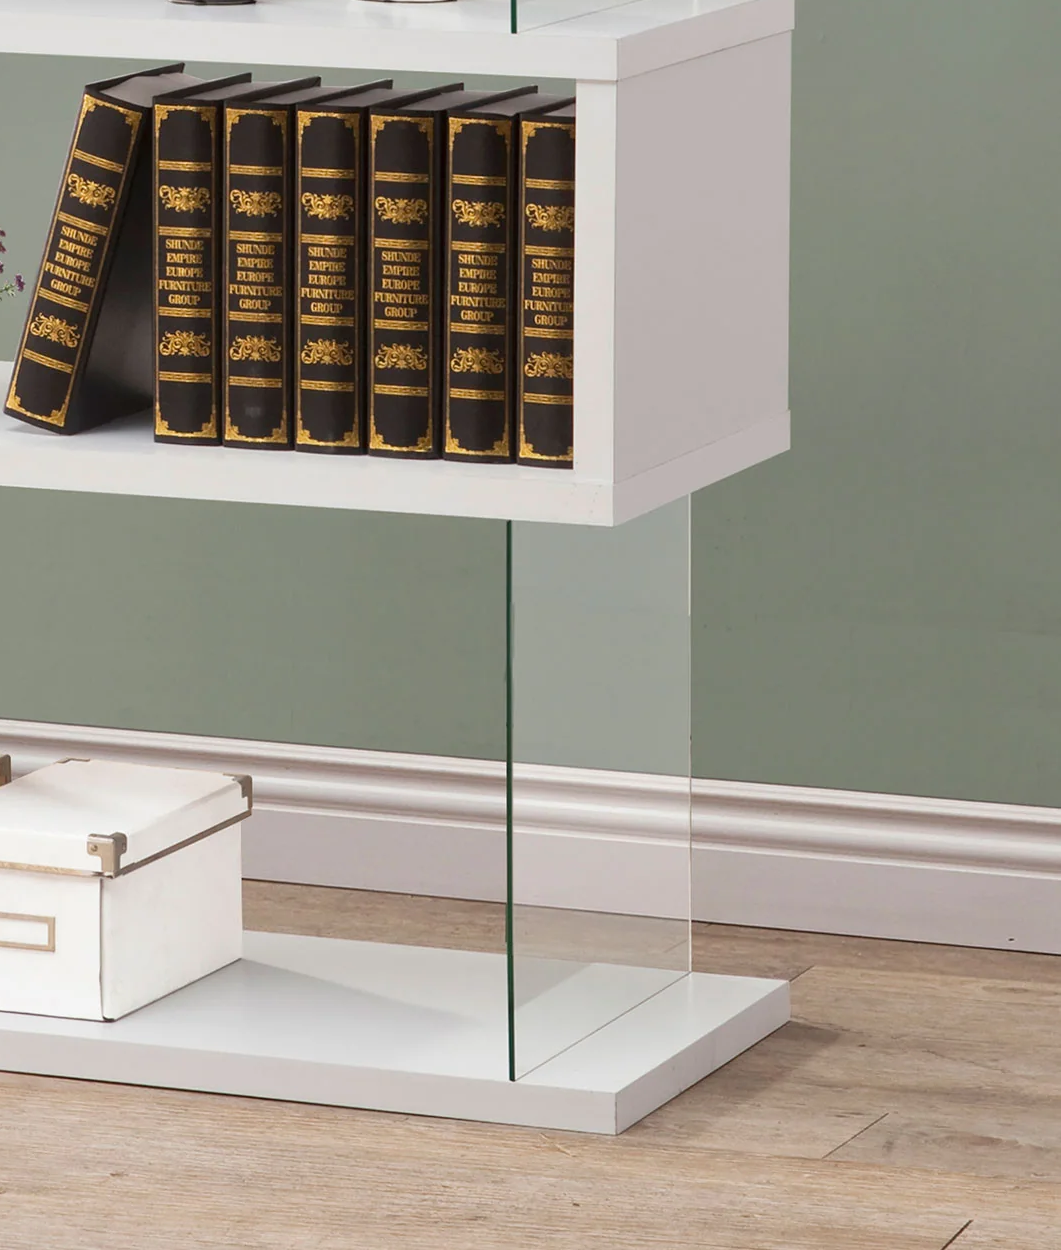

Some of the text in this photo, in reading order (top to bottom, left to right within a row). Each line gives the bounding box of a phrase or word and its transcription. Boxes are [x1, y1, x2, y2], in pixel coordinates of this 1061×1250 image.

[60, 226, 97, 247] SHUNDE
[58, 239, 93, 259] EMPIRE
[166, 239, 204, 250] SHUNDE
[236, 243, 274, 255] SHUNDE
[166, 253, 202, 263] EMPIRE
[308, 247, 347, 258] SHUNDE
[381, 251, 421, 263] SHUNDE
[54, 252, 90, 272] EUROPE
[237, 257, 273, 268] EMPIRE
[458, 254, 498, 266] SHUNDE
[531, 259, 571, 270] SHUNDE
[309, 261, 346, 272] EMPIRE
[382, 265, 420, 276] EMPIRE
[44, 262, 96, 288] FURNITURE
[166, 267, 203, 278] EUROPE
[236, 271, 274, 282] EUROPE
[459, 268, 496, 280] EMPIRE
[308, 275, 346, 286] EUROPE
[532, 273, 570, 284] EMPIRE
[50, 278, 81, 296] GROUP
[158, 280, 211, 292] FURNITURE
[382, 279, 420, 290] EUROPE
[458, 282, 497, 294] EUROPE
[229, 285, 282, 297] FURNITURE
[301, 288, 354, 299] FURNITURE
[532, 286, 570, 298] EUROPE
[168, 294, 200, 305] GROUP
[374, 292, 428, 304] FURNITURE
[451, 295, 505, 308] FURNITURE
[239, 299, 271, 310] GROUP
[310, 302, 343, 313] GROUP
[384, 306, 418, 318] GROUP
[461, 311, 494, 322] GROUP
[534, 314, 567, 326] GROUP
